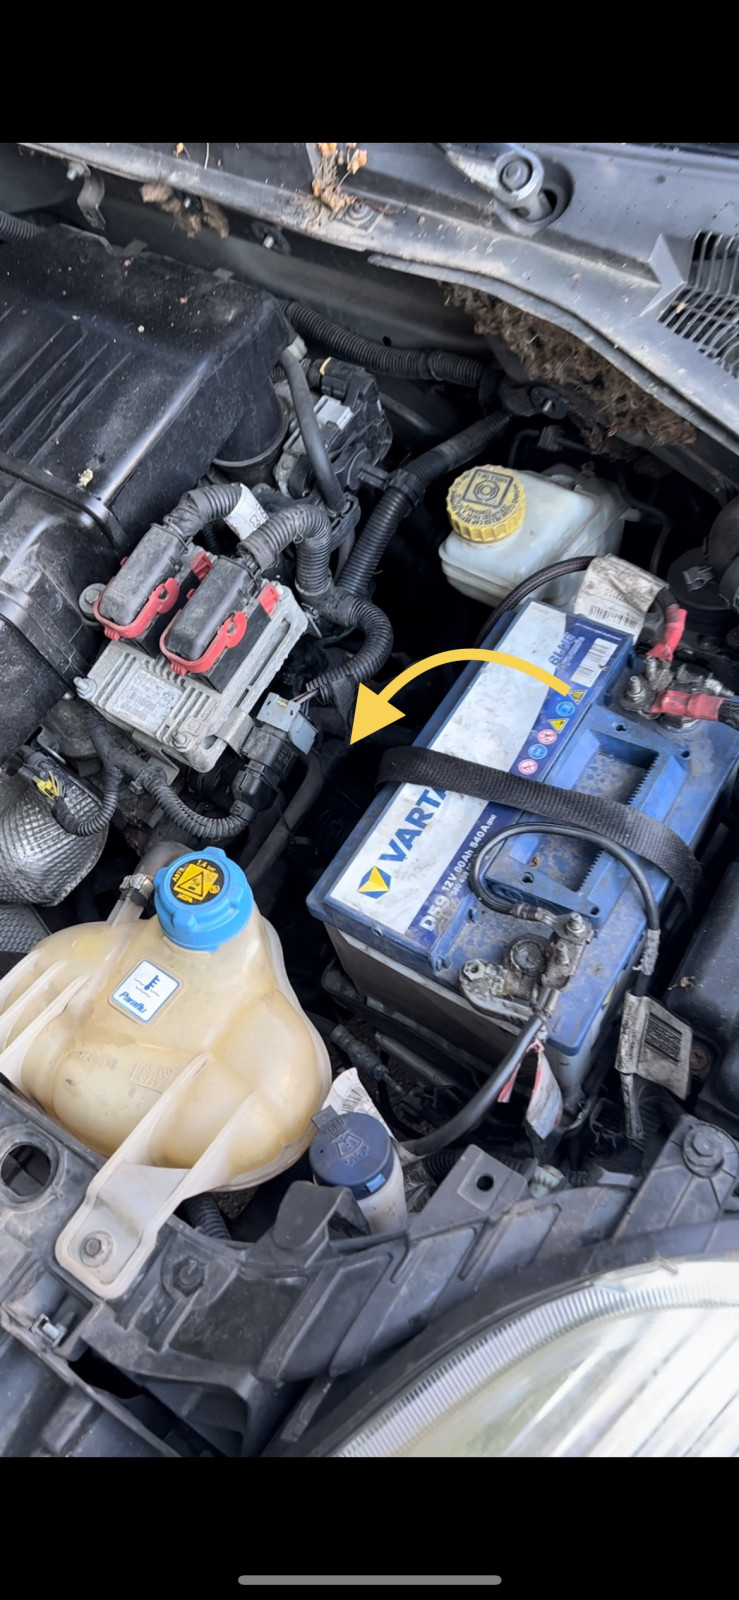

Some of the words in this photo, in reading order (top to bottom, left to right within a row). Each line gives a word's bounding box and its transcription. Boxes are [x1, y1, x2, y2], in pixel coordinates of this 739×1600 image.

[548, 631, 576, 666] BLUE
[442, 873, 457, 891] 12V
[418, 895, 449, 932] D59
[118, 991, 148, 1014] Paraflu
